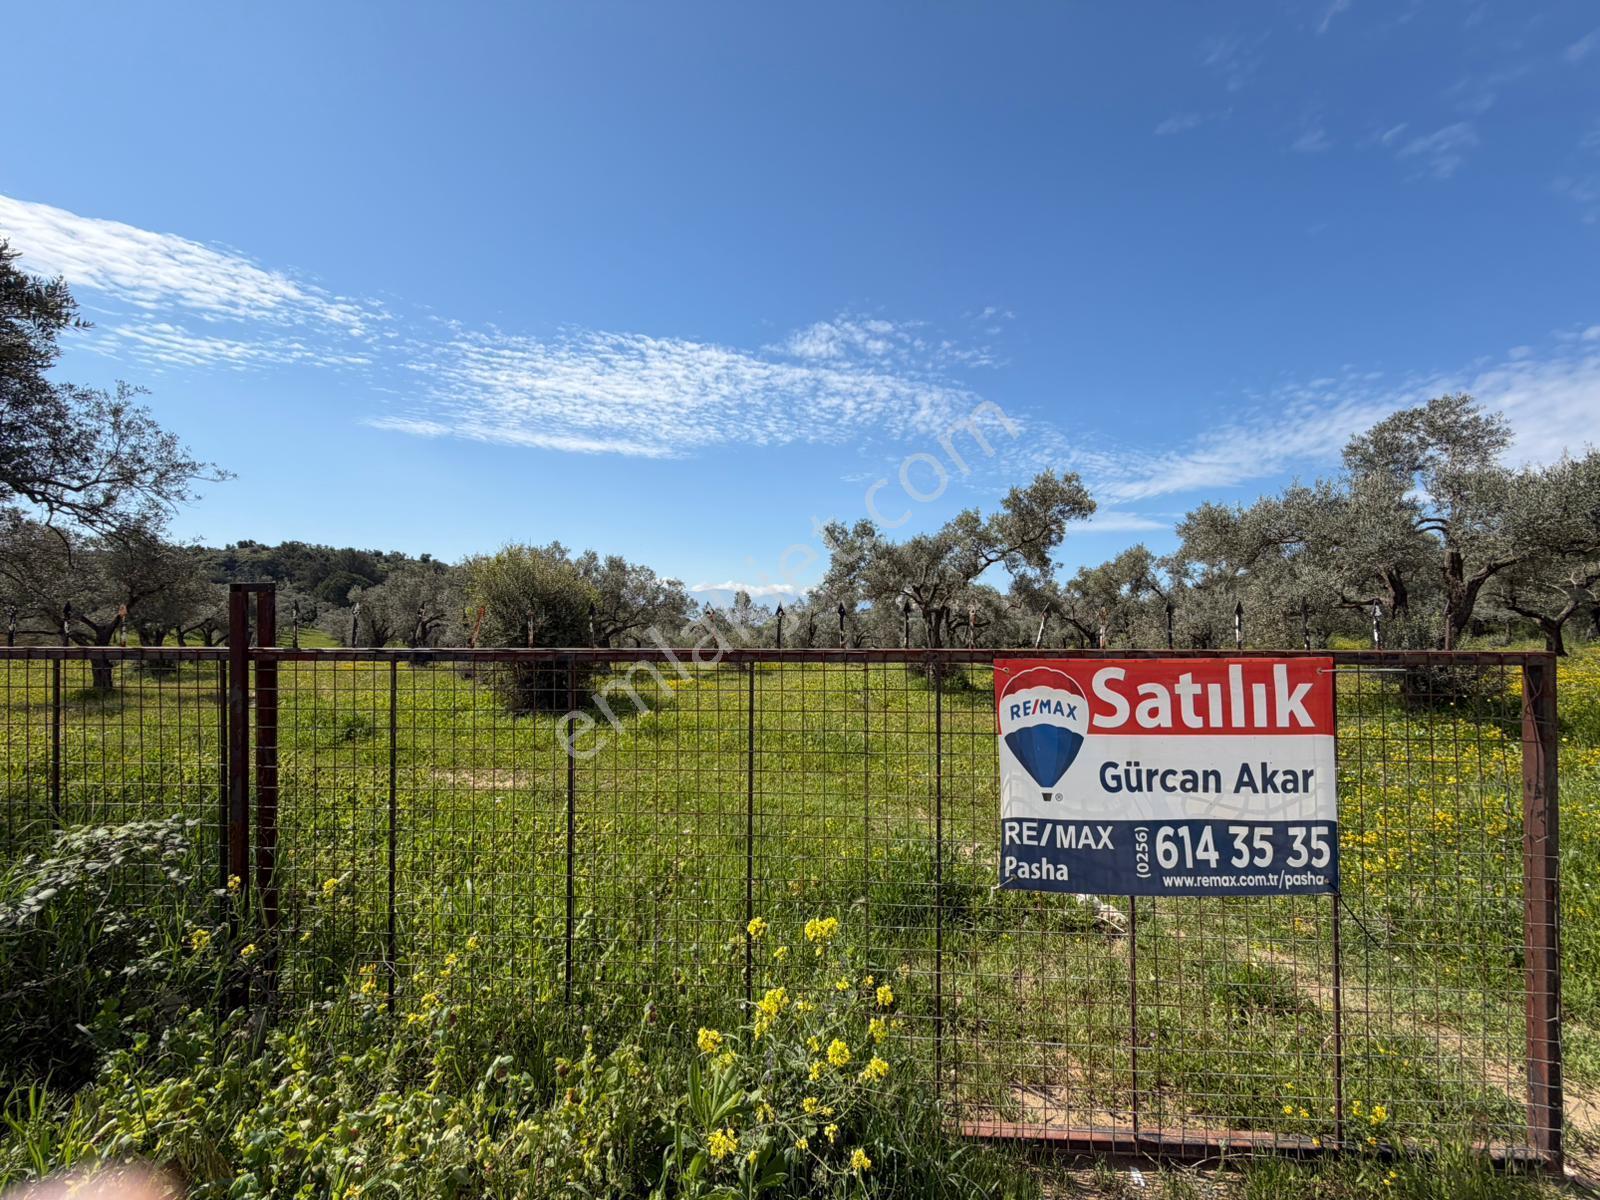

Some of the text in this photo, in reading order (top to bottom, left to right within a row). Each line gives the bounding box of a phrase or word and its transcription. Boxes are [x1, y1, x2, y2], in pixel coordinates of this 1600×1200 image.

[1010, 699, 1077, 721] RE/MAX
[1091, 664, 1315, 729] Satılık
[1100, 761, 1314, 793] Gürcan Akar
[1004, 822, 1114, 850] RE/MAX
[1155, 825, 1331, 869] 614 35 35
[1135, 826, 1151, 878] (0256)
[1004, 857, 1069, 881] Pasha
[1162, 870, 1325, 889] www.remax.com.tr/pasha
